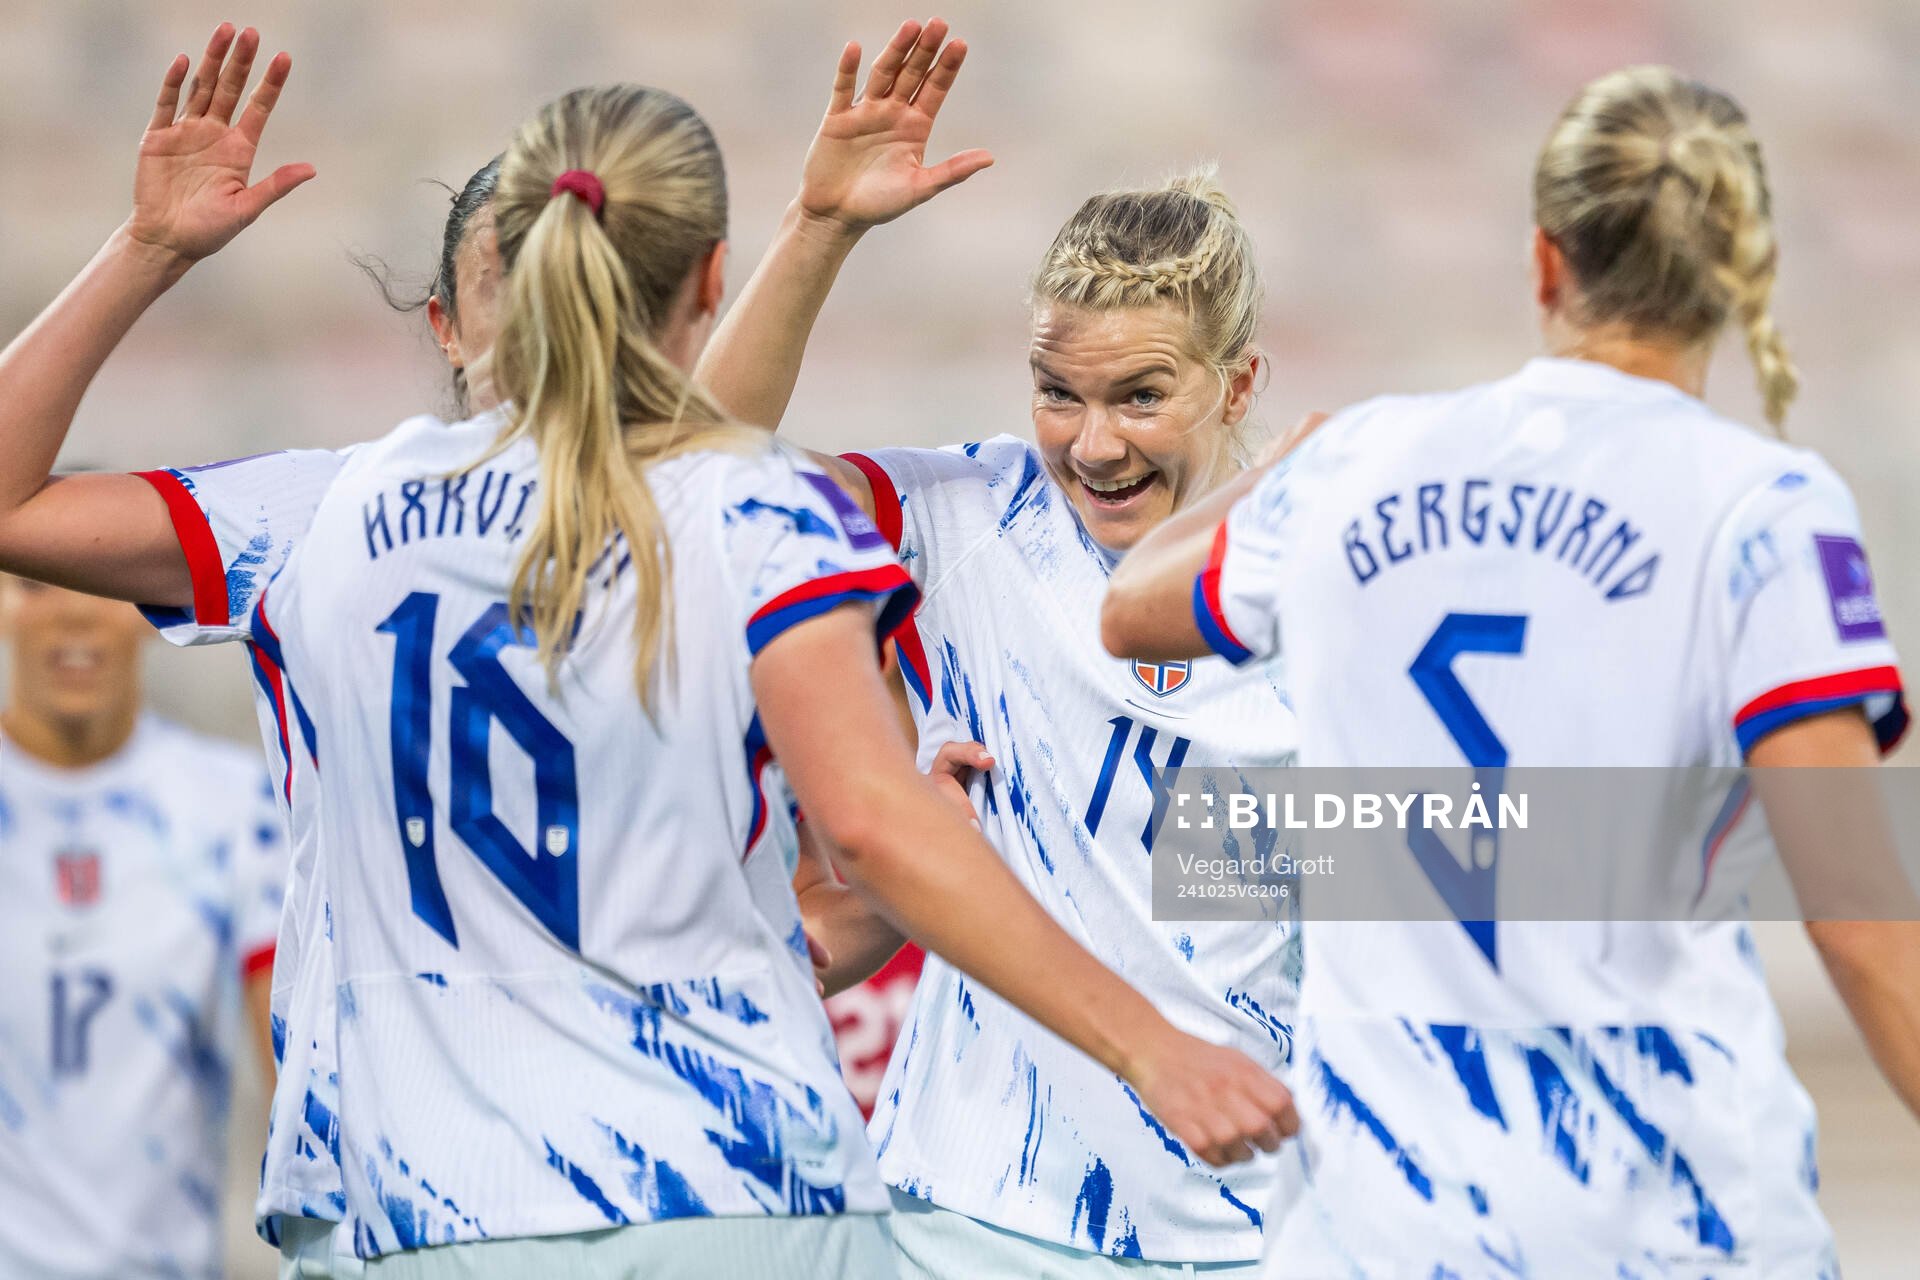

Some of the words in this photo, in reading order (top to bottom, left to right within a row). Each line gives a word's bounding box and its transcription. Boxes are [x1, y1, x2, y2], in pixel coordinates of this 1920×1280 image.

[1342, 480, 1660, 602] BERGSVAND
[1084, 715, 1191, 857] 14
[50, 967, 115, 1079] 17
